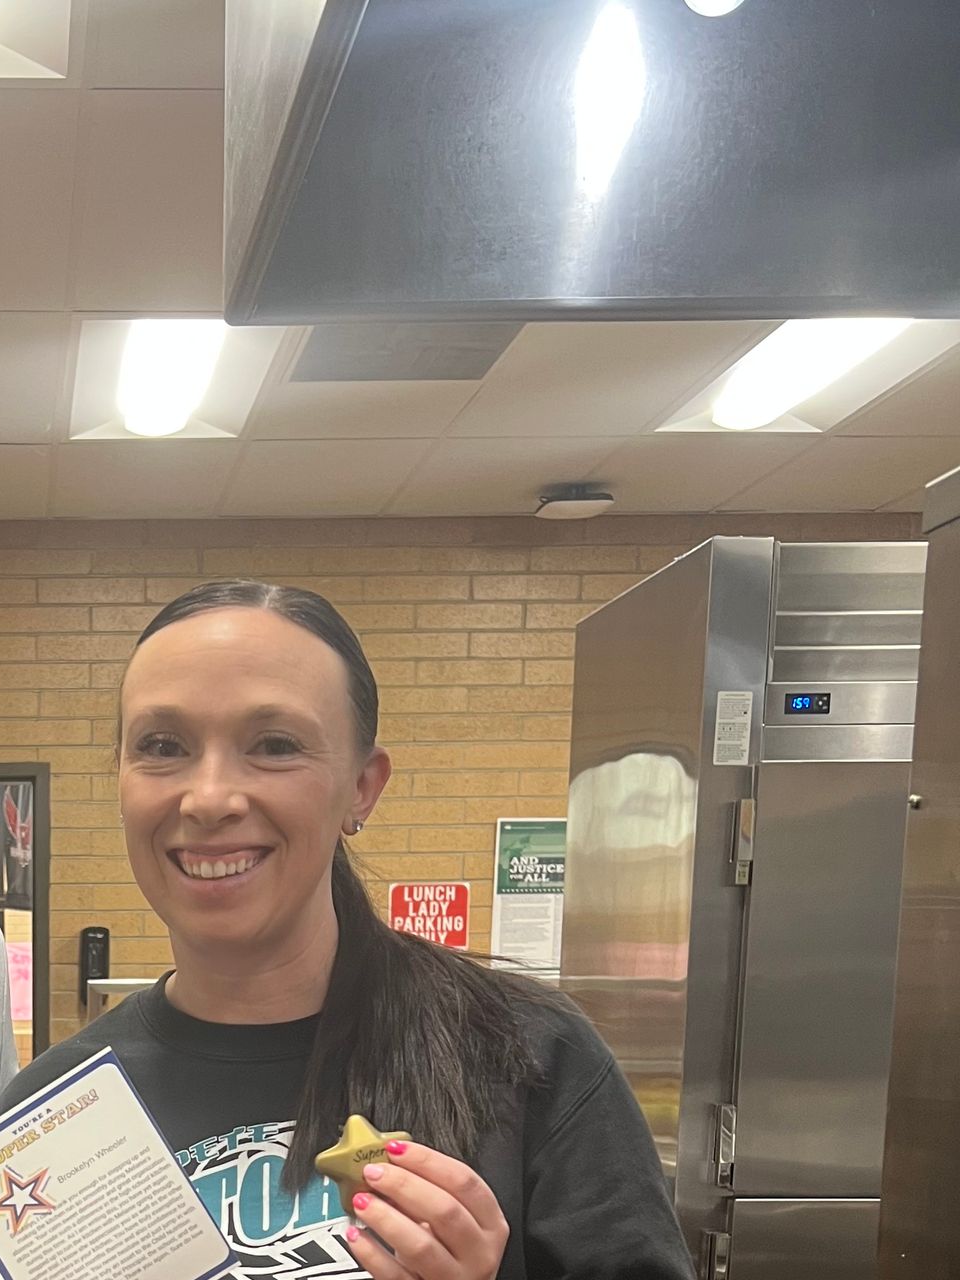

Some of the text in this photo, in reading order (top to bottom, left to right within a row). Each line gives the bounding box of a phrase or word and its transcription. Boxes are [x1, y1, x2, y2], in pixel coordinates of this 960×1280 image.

[509, 864, 564, 874] JUSTICE
[510, 856, 539, 866] AND
[524, 873, 549, 883] ALL
[404, 885, 456, 902] LUNCH
[408, 901, 450, 916] LADY
[394, 916, 464, 932] PARKING
[41, 1089, 99, 1134] STAR!
[11, 1113, 45, 1136] YOU'RE
[56, 1135, 128, 1185] Brookelyn Wheeler
[353, 1148, 387, 1164] Super
